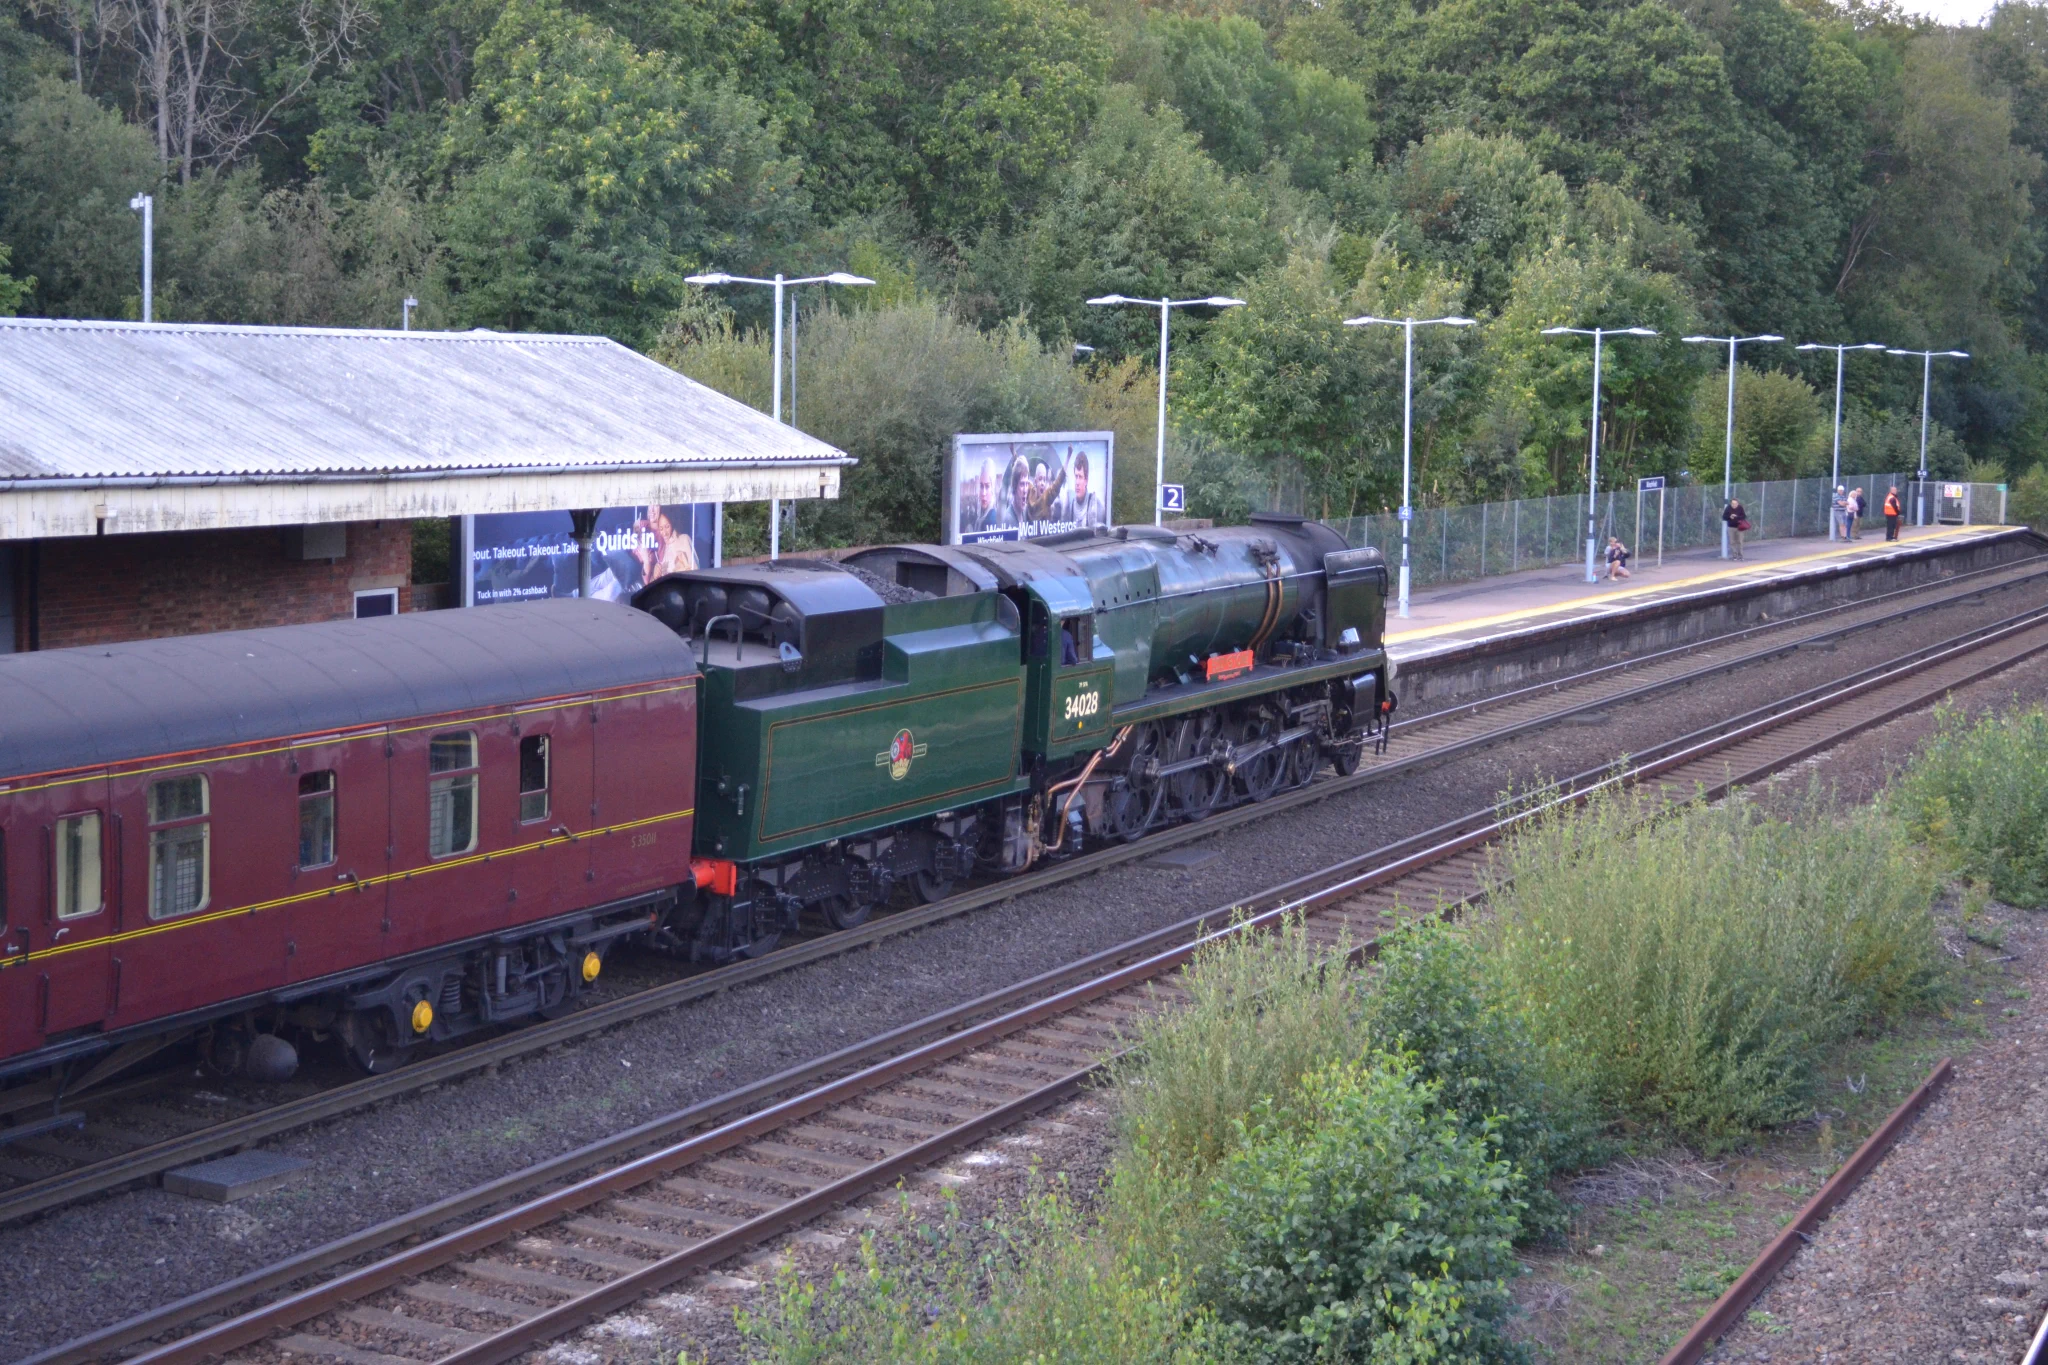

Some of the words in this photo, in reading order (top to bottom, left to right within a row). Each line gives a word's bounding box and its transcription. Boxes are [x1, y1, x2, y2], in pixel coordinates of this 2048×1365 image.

[1167, 488, 1179, 507] 2
[1401, 507, 1408, 516] 4
[1019, 520, 1038, 537] Wall
[493, 546, 527, 559] Takeout.
[528, 543, 561, 557] Takeout.
[596, 528, 638, 556] Quids
[641, 526, 659, 549] in.
[477, 590, 491, 600] Tuck
[492, 589, 499, 598] in
[499, 588, 512, 598] with
[513, 587, 522, 597] 2%
[522, 585, 548, 596] cashback
[1065, 691, 1099, 720] 34028
[631, 836, 637, 848] S
